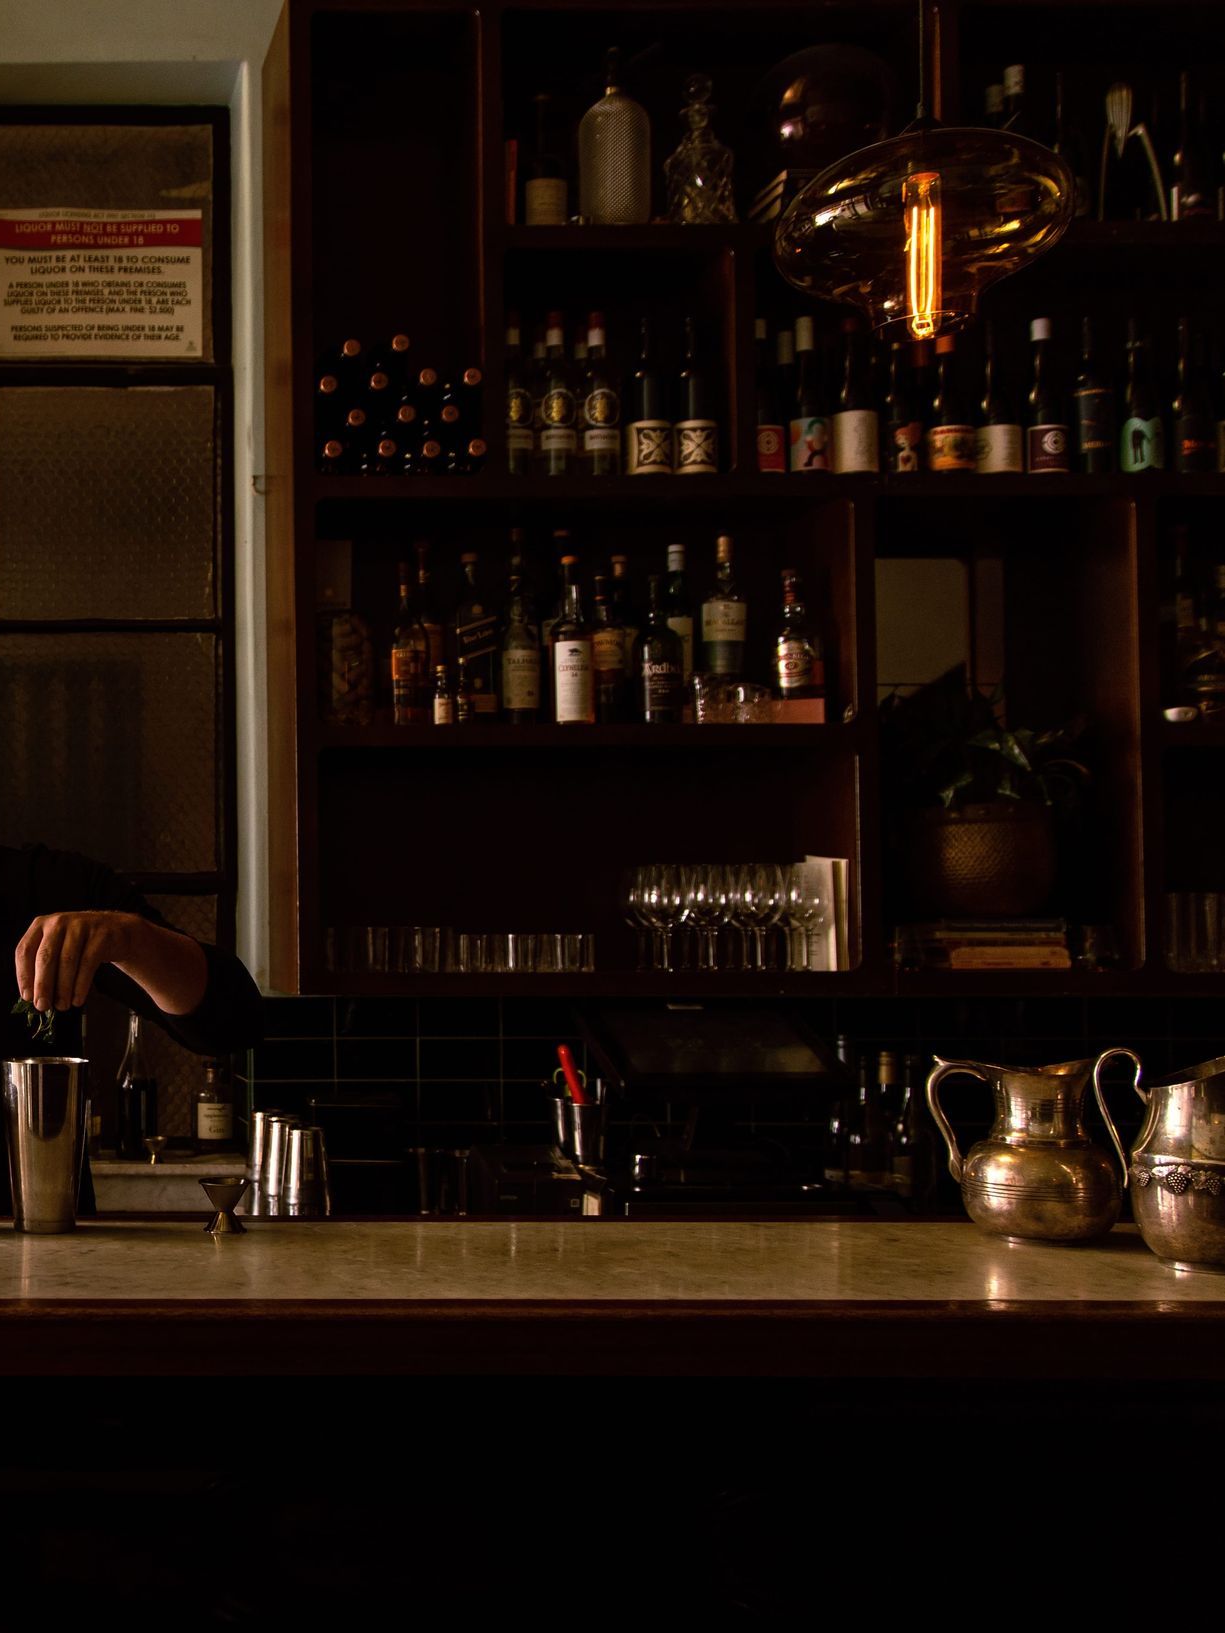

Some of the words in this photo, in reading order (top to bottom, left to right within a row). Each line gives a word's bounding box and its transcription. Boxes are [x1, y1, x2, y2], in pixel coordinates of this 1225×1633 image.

[15, 222, 52, 233] LIQUOR
[55, 221, 80, 231] MUST
[83, 223, 103, 233] NOT
[106, 223, 119, 233] BE
[120, 223, 164, 234] SUPPLIED
[166, 223, 180, 233] TO
[51, 233, 94, 244] PERSONS
[97, 235, 129, 245] UNDER
[133, 235, 144, 245] 18
[5, 255, 24, 265] YOU
[27, 255, 52, 264] MUST
[55, 254, 66, 263] BE
[70, 254, 81, 263] AT
[83, 255, 110, 263] LEAST
[114, 255, 123, 264] 18
[126, 255, 139, 264] TO
[141, 255, 191, 265] CONSUME
[30, 265, 66, 275] LIQUOR
[69, 265, 85, 274] ON
[88, 265, 115, 274] THESE
[8, 281, 14, 289] A
[16, 281, 44, 289] PERSON
[45, 280, 69, 289] UNDER
[72, 280, 80, 288] 18
[81, 280, 100, 288] WHO
[101, 280, 131, 288] OBTAINS
[145, 280, 186, 289] CONSUMES
[7, 289, 34, 298] LIQUOR
[36, 289, 48, 297] ON
[49, 289, 70, 297] THESE
[108, 289, 124, 297] AND
[126, 289, 138, 297] THE
[139, 289, 168, 297] PERSON
[169, 289, 188, 297] WHO
[35, 298, 61, 306] LIQUOR
[171, 298, 191, 306] EACH
[21, 306, 44, 314] GUILTY
[46, 306, 56, 314] OF
[58, 306, 69, 314] AN
[71, 306, 104, 314] OFFENCE
[11, 325, 43, 333] PERSONS
[44, 325, 83, 333] SUSPECTED
[85, 324, 95, 333] OF
[97, 324, 120, 333] BEING
[121, 324, 146, 332] UNDER
[157, 324, 174, 332] MAY
[13, 333, 49, 341] REQUIRED
[50, 333, 60, 341] TO
[61, 333, 92, 341] PROVIDE
[93, 333, 130, 341] EVIDENCE
[131, 333, 142, 341] OF
